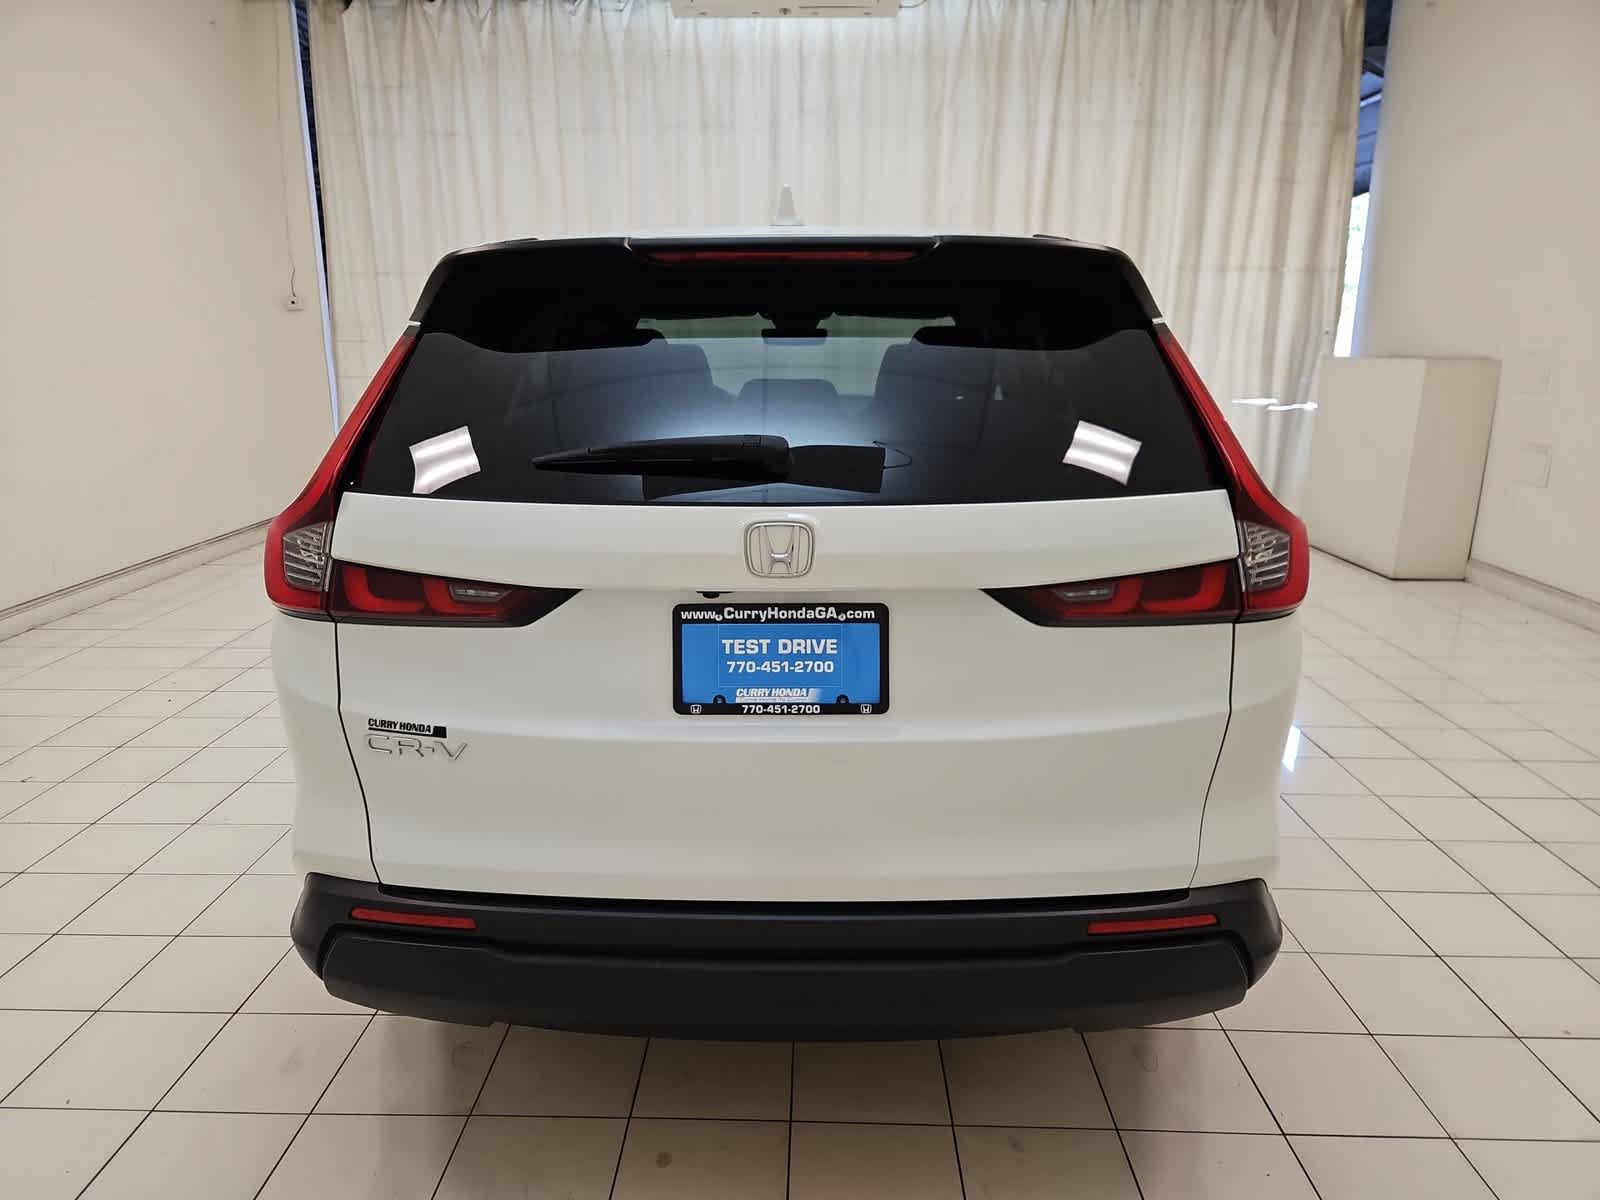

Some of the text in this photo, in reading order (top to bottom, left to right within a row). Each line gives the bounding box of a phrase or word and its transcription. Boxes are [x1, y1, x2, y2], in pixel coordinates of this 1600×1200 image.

[681, 606, 875, 622] www.CurryHondaGA.com
[721, 638, 838, 654] TEST DRIVE
[726, 660, 834, 673] 770-451-2700
[736, 687, 808, 697] CURRY HONDA
[742, 704, 821, 714] 770-451-2700
[367, 718, 431, 733] CURRY HONDA
[365, 733, 468, 761] CR-V
